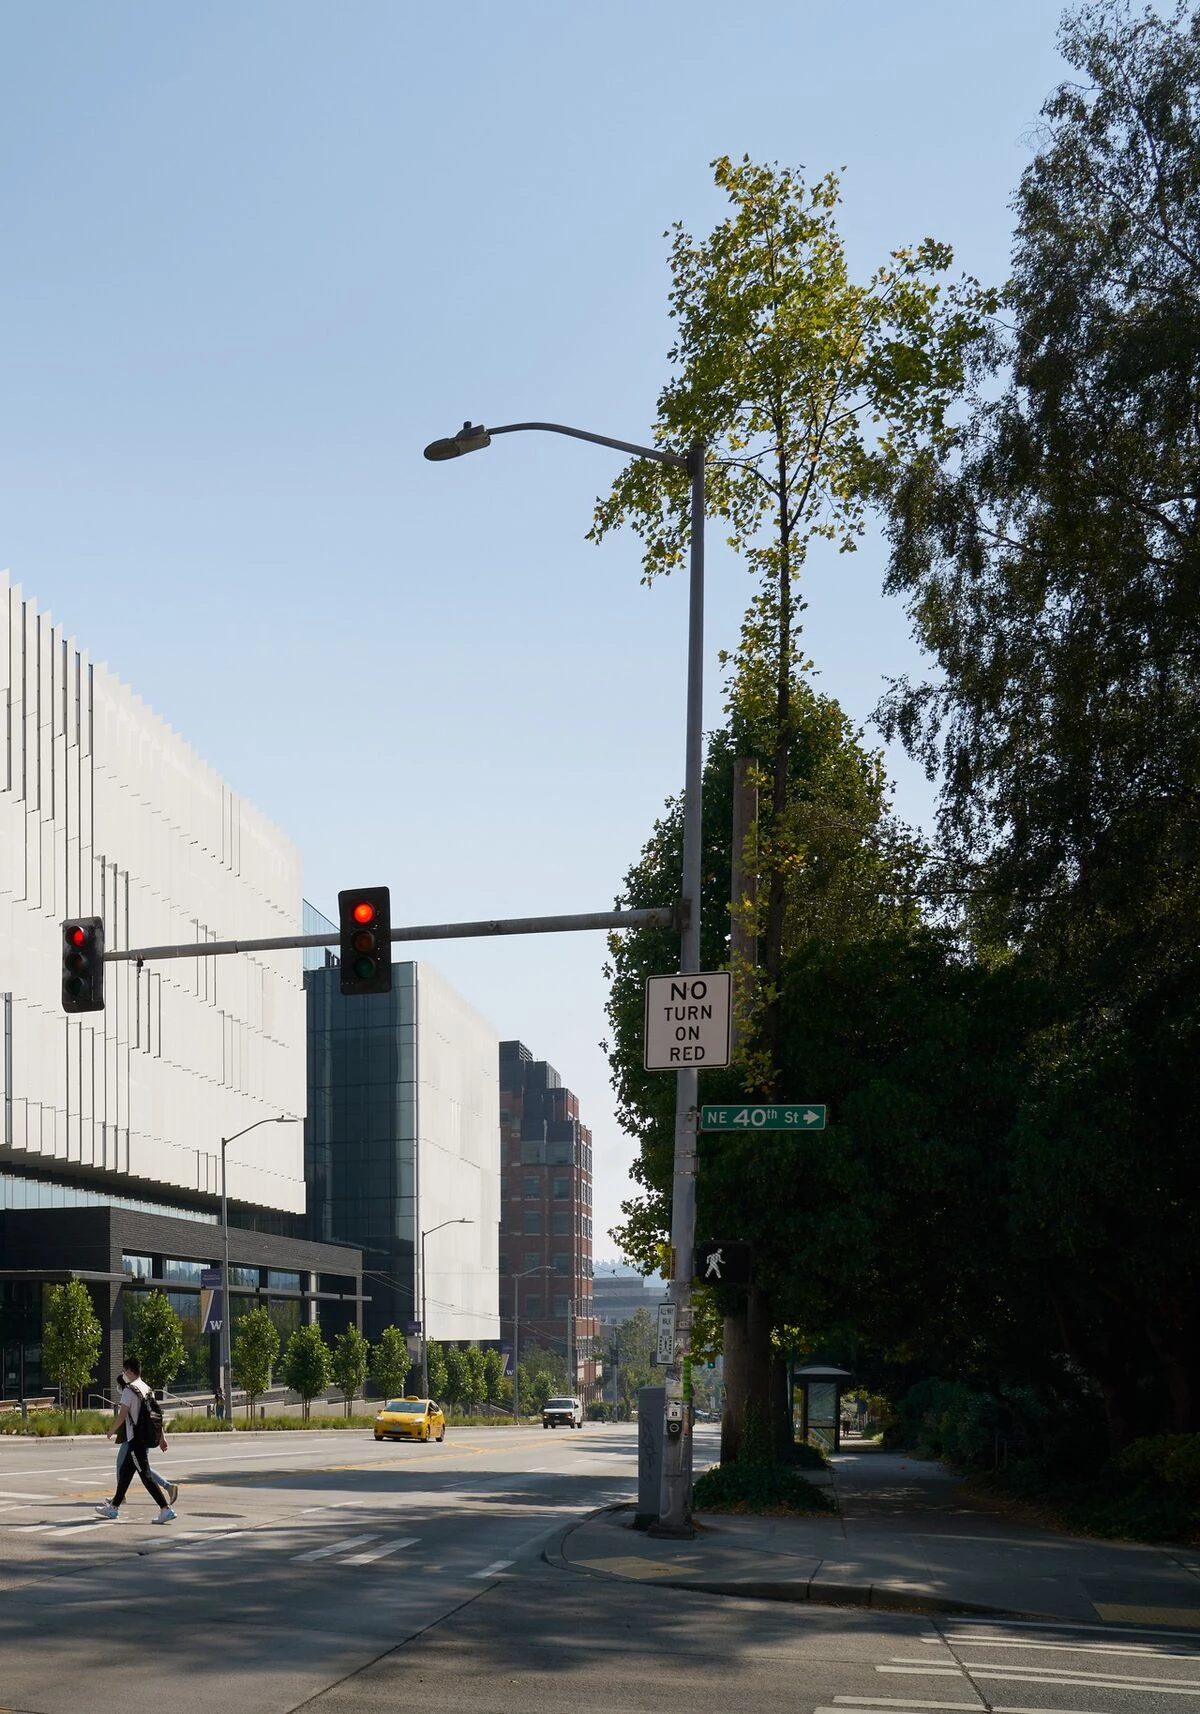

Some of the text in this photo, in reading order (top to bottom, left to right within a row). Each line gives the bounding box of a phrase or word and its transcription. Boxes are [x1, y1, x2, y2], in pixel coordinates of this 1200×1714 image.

[671, 981, 708, 1001] NO
[664, 1005, 712, 1022] TURN
[675, 1026, 700, 1041] ON
[670, 1046, 705, 1061] RED
[707, 1109, 799, 1127] NE 40th St
[209, 1320, 223, 1330] W
